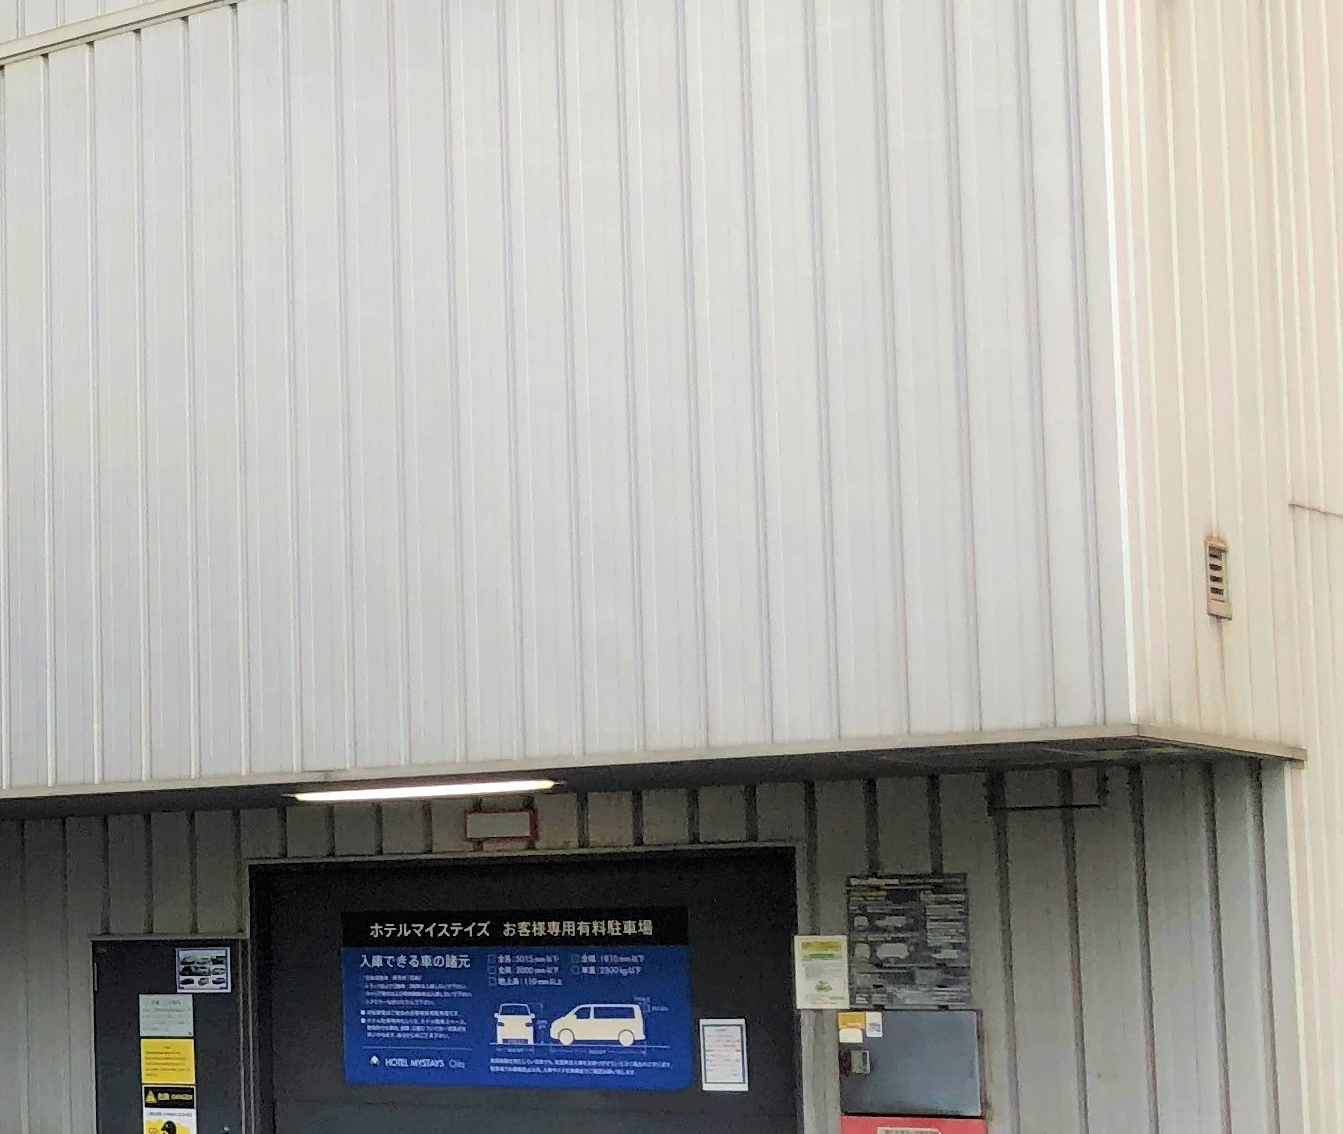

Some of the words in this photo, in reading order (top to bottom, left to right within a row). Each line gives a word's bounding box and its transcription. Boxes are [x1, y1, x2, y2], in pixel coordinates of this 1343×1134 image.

[370, 921, 490, 938] ホテルマイステイズ
[503, 920, 652, 937] お客様専用有料駐車場
[360, 955, 470, 968] 入庫できる車の諸元
[385, 1058, 409, 1068] HOTEL
[410, 1058, 445, 1068] MYSTAYS
